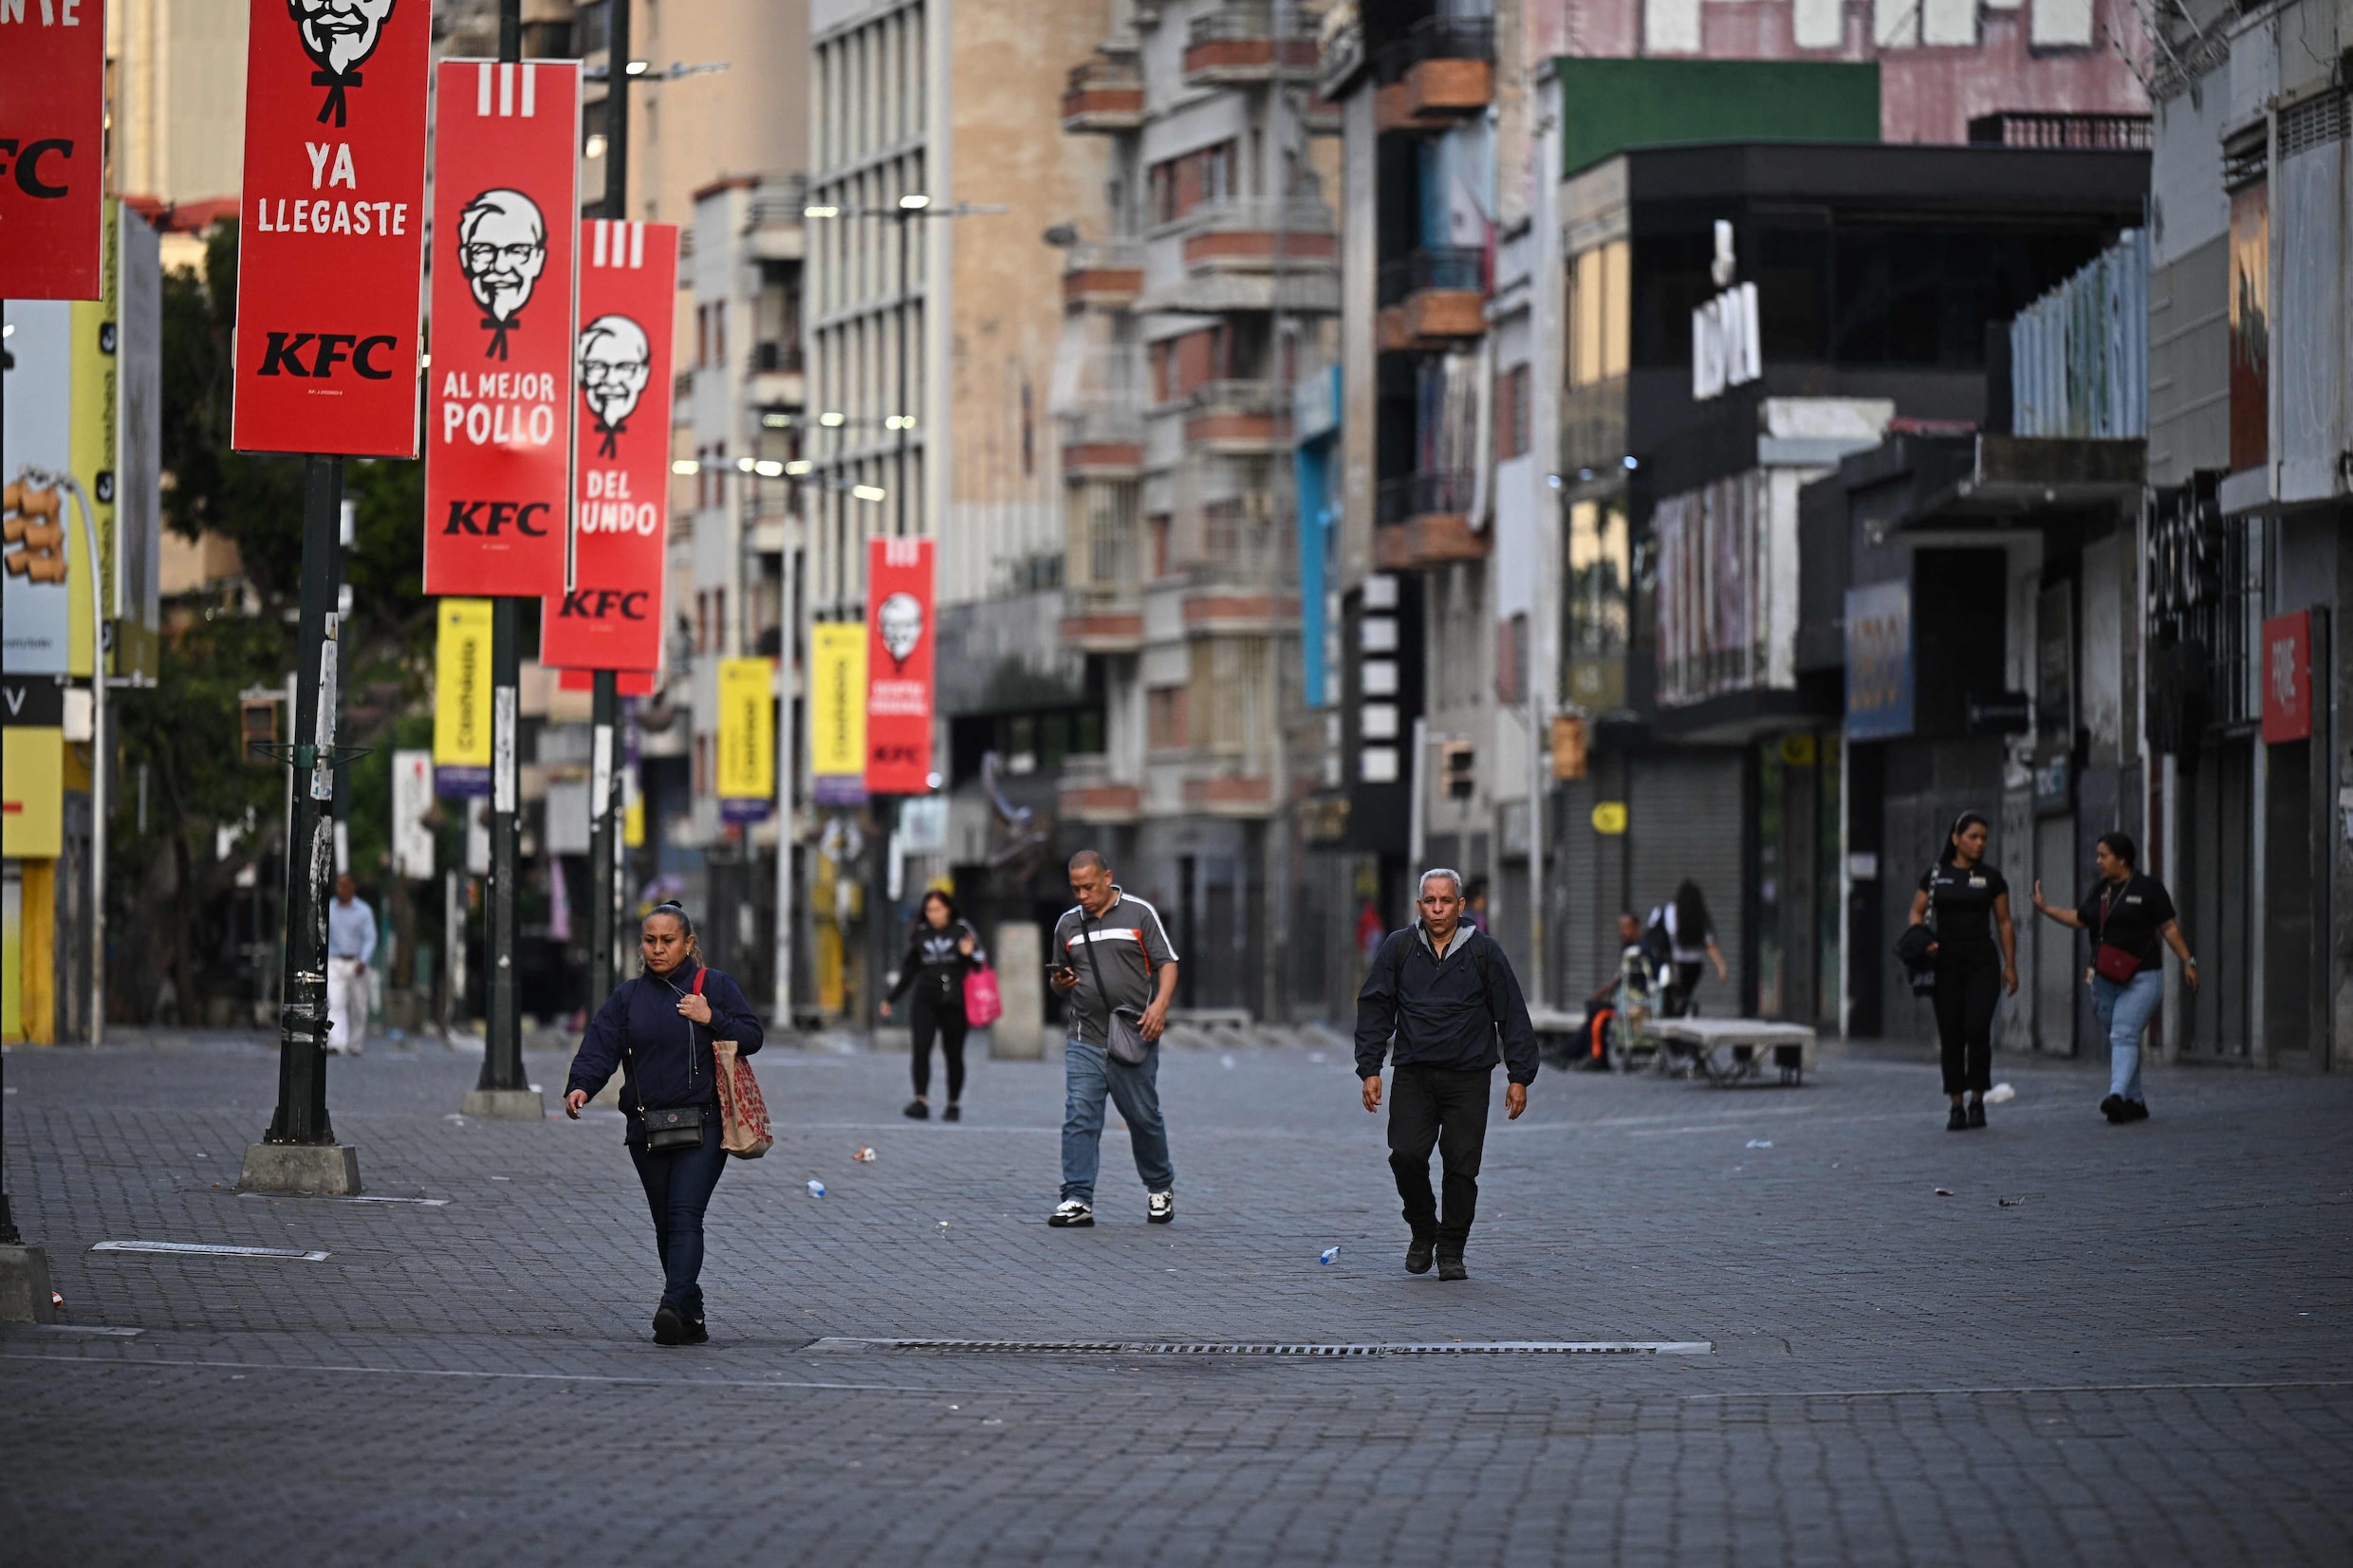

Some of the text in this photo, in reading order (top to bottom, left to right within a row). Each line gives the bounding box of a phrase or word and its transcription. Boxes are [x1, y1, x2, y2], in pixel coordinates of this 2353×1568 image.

[305, 141, 356, 190] YA
[258, 197, 408, 236] LLEGASTE
[257, 332, 398, 379] KFC
[442, 370, 556, 402] AL MEJOR
[443, 402, 554, 446] POLLO
[586, 470, 631, 499] DEL
[442, 501, 550, 537] KFC
[574, 501, 657, 536] UNDO
[558, 588, 649, 619] KFC
